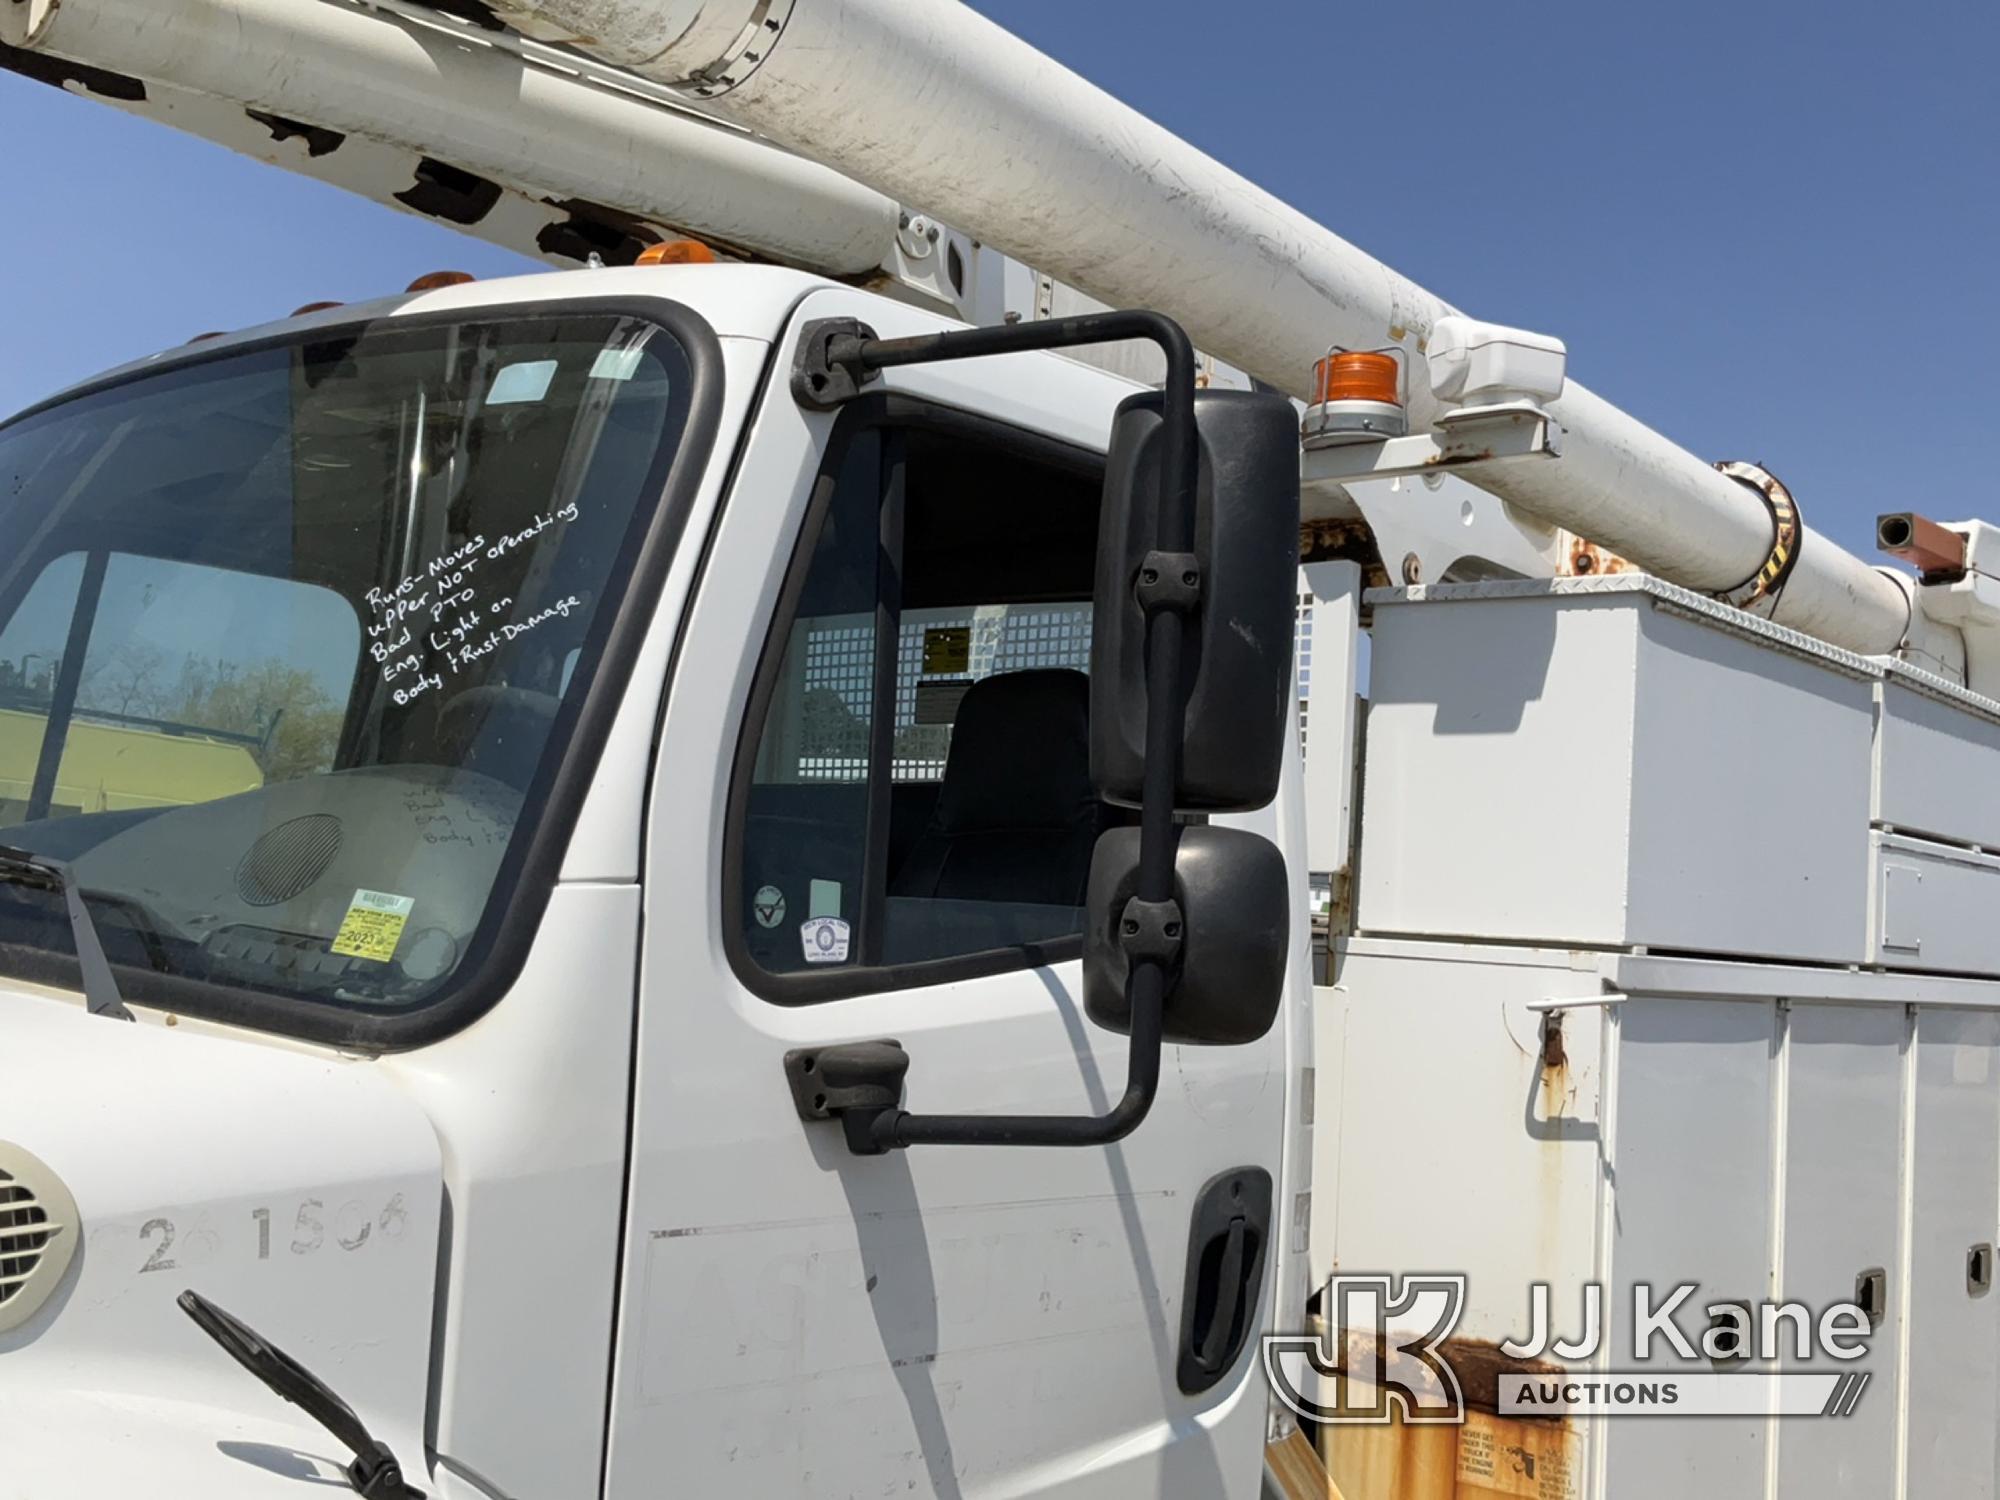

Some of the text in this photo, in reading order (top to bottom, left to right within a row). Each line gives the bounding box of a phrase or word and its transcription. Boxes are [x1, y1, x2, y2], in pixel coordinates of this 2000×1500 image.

[429, 534, 485, 576] Moves
[438, 558, 478, 595] NOT
[370, 588, 475, 662] Bad PTO
[393, 673, 444, 705] Body
[459, 632, 501, 664] Rust
[501, 595, 581, 641] Damage
[430, 610, 481, 650] Light
[491, 596, 513, 613] on
